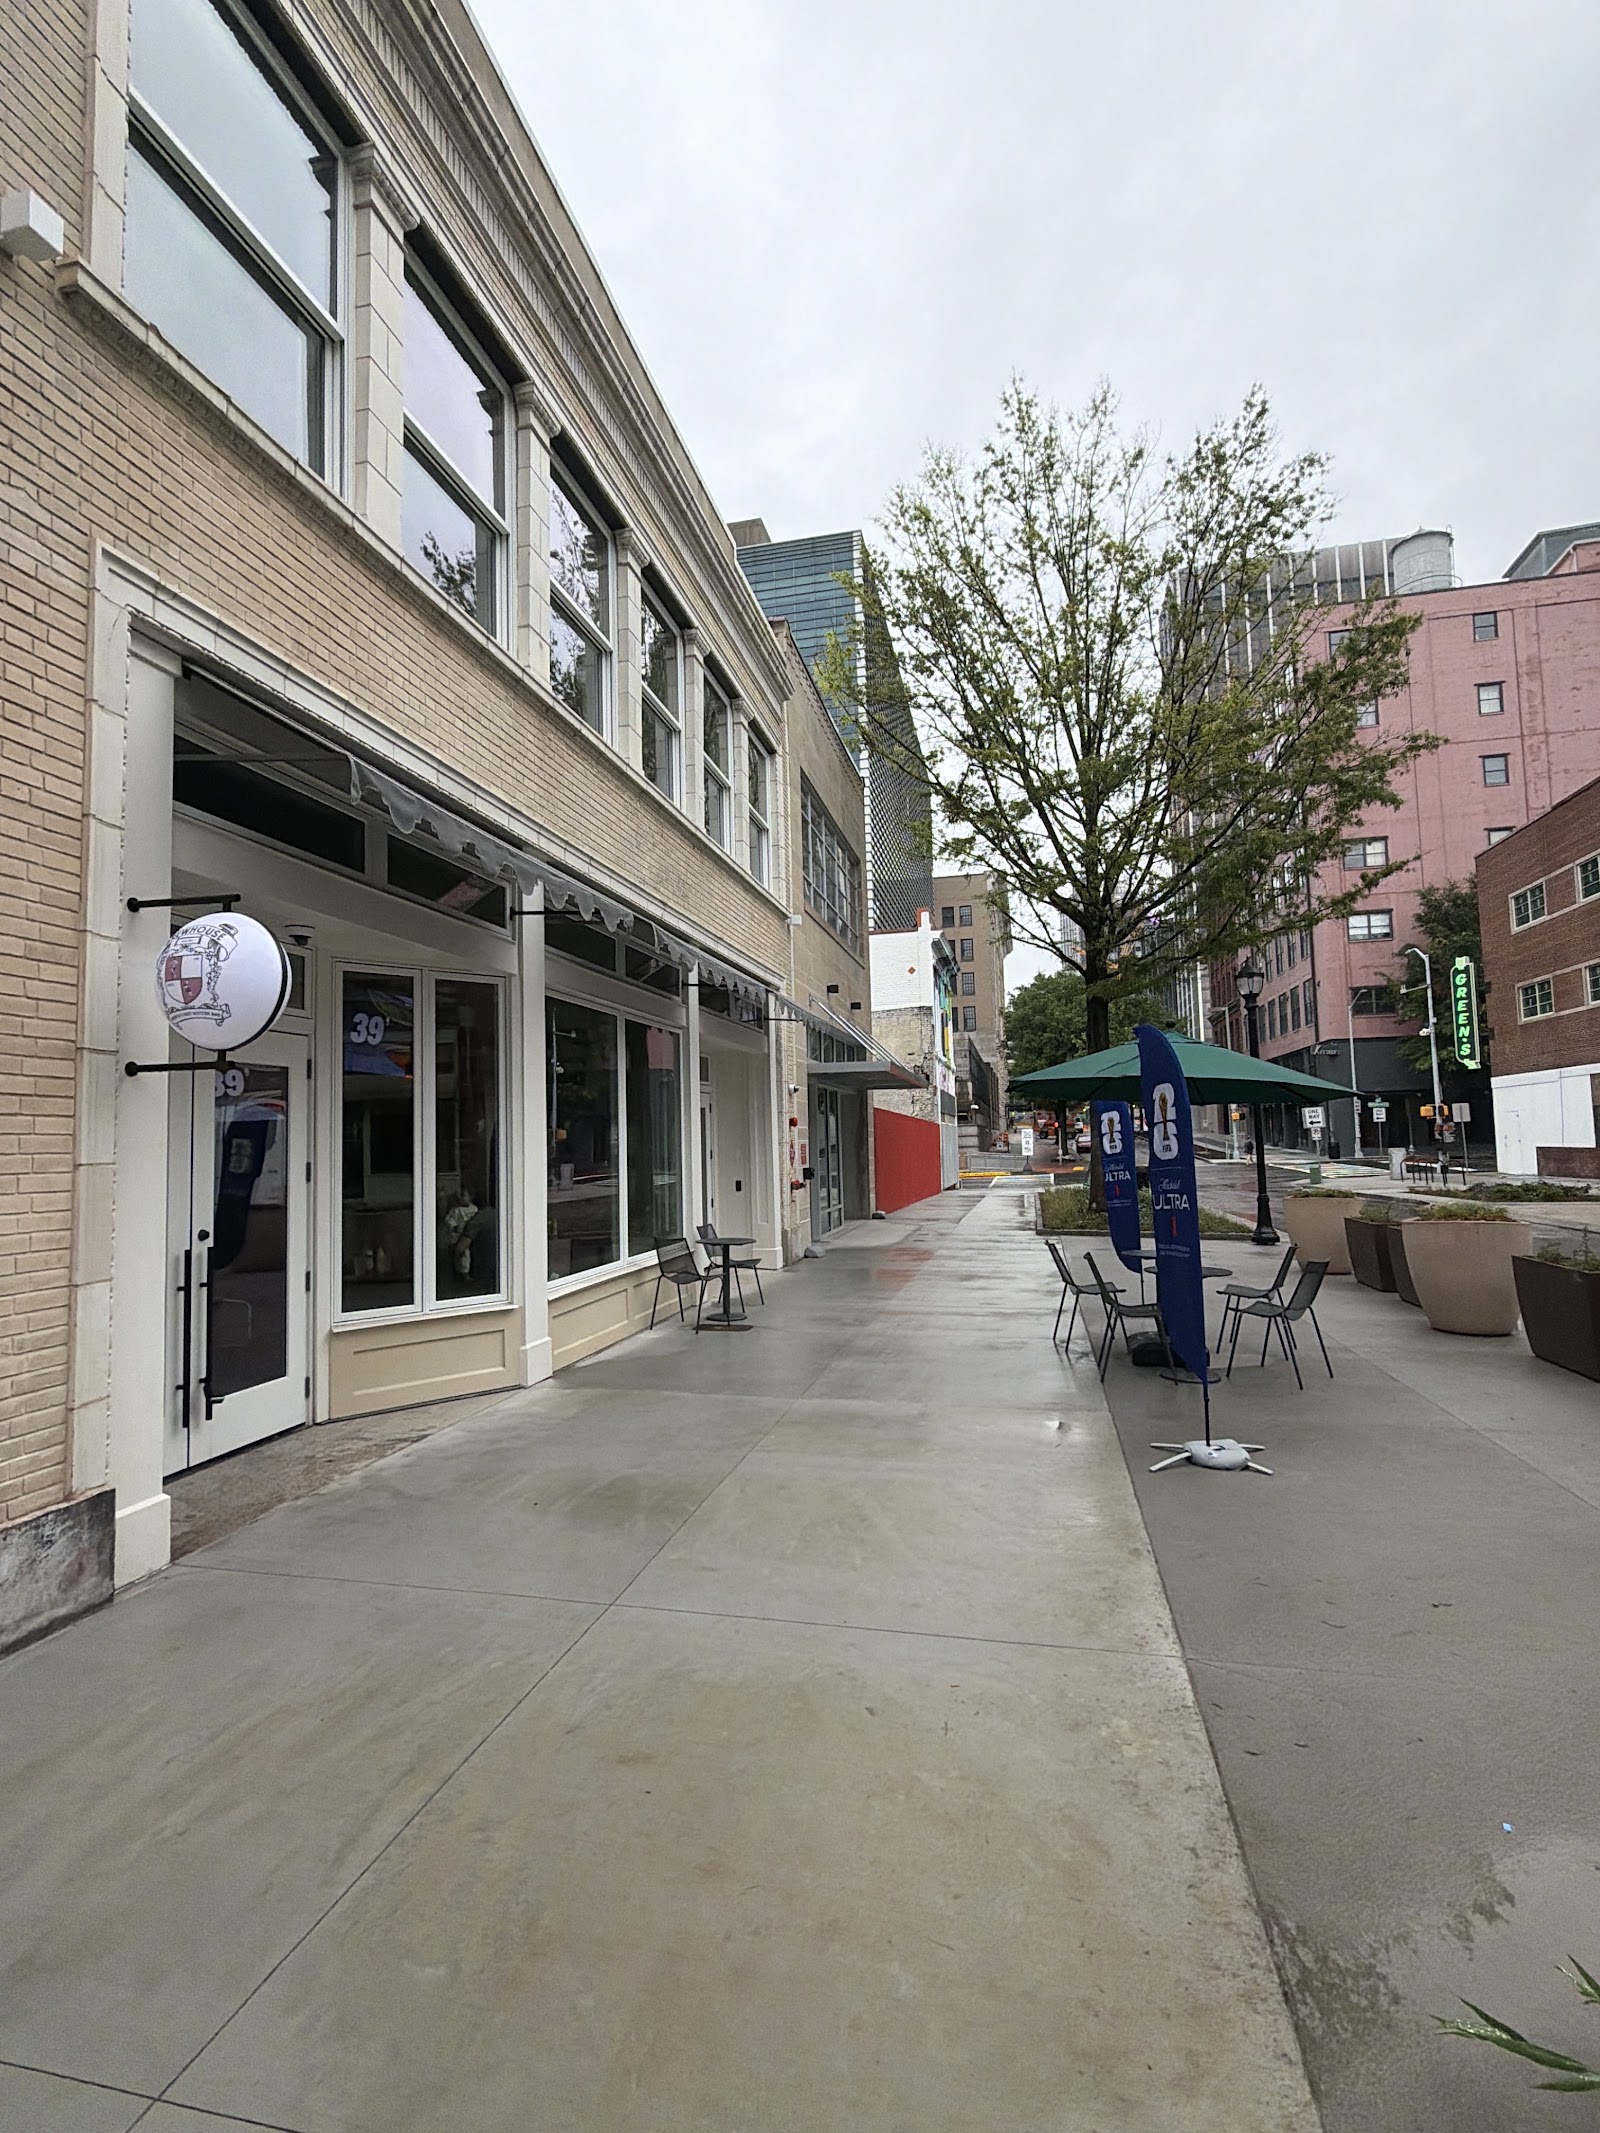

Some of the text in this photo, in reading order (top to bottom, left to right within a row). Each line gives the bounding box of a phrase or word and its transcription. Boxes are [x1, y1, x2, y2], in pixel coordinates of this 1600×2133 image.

[180, 926, 227, 941] WHOUSE
[1455, 973, 1471, 1056] GREEN'S
[1152, 1193, 1191, 1211] ULTRA
